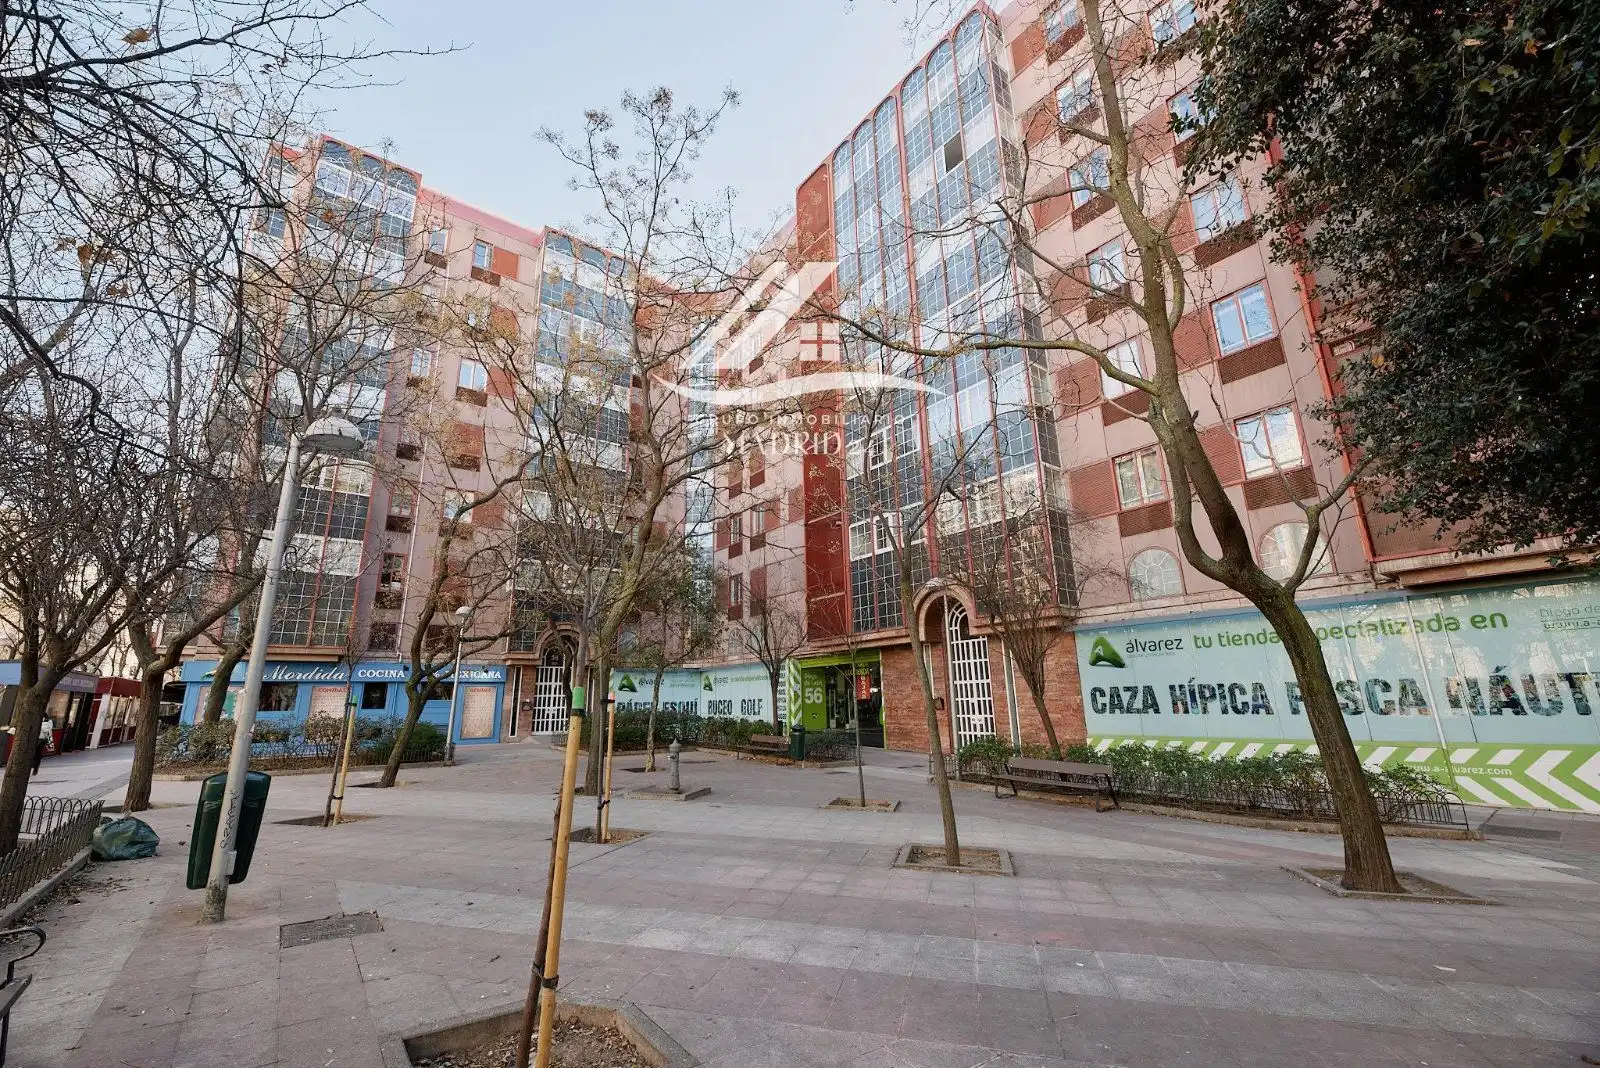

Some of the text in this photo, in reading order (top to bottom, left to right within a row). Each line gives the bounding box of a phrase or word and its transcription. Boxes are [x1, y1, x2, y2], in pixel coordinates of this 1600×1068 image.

[1193, 634, 1213, 649] tu
[1218, 628, 1282, 648] tienda
[1470, 611, 1509, 629] en
[1126, 638, 1183, 653] álvarez
[264, 665, 346, 680] Mordida
[358, 669, 406, 678] COCINA
[804, 687, 823, 704] 56
[1090, 665, 1600, 717] CAZA HÍPICA PSCA NÁUT
[708, 698, 763, 716] BUCEO GOLF
